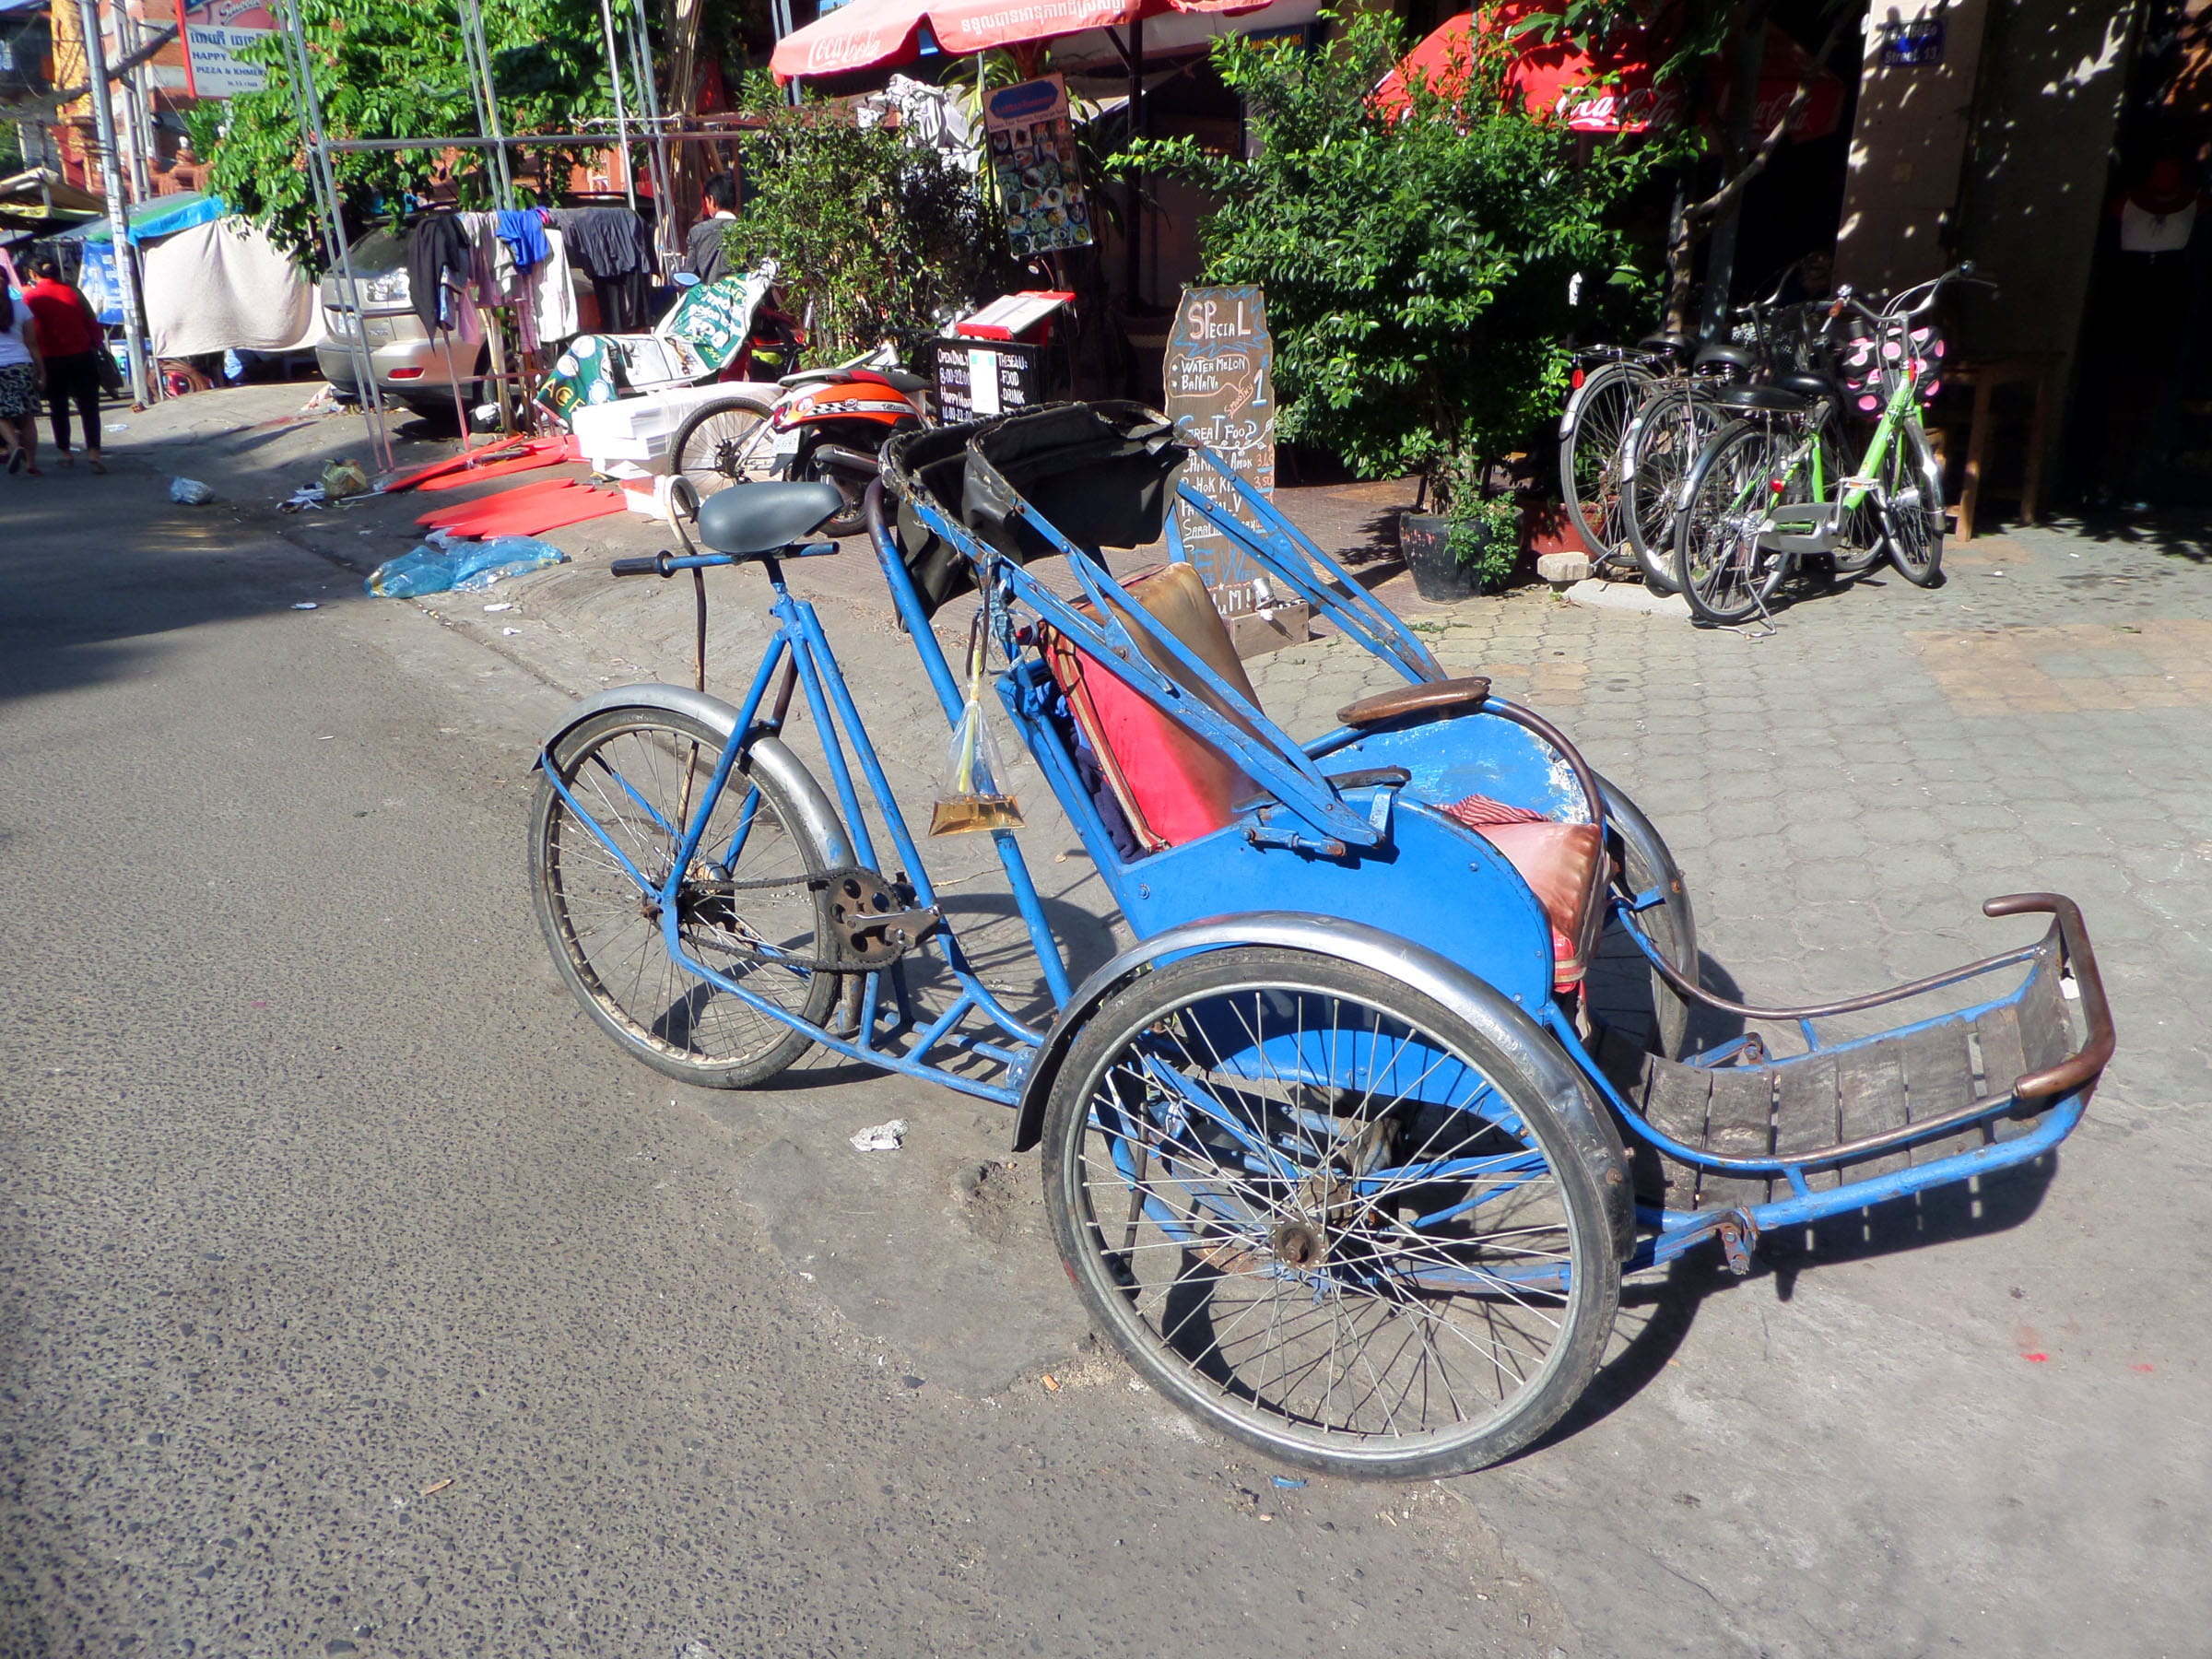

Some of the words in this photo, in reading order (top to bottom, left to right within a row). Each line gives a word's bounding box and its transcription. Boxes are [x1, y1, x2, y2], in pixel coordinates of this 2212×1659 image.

[192, 52, 227, 61] HAPPY
[195, 65, 222, 74] PIZZA
[1002, 370, 1019, 386] FOOD
[1003, 387, 1025, 405] DRINK
